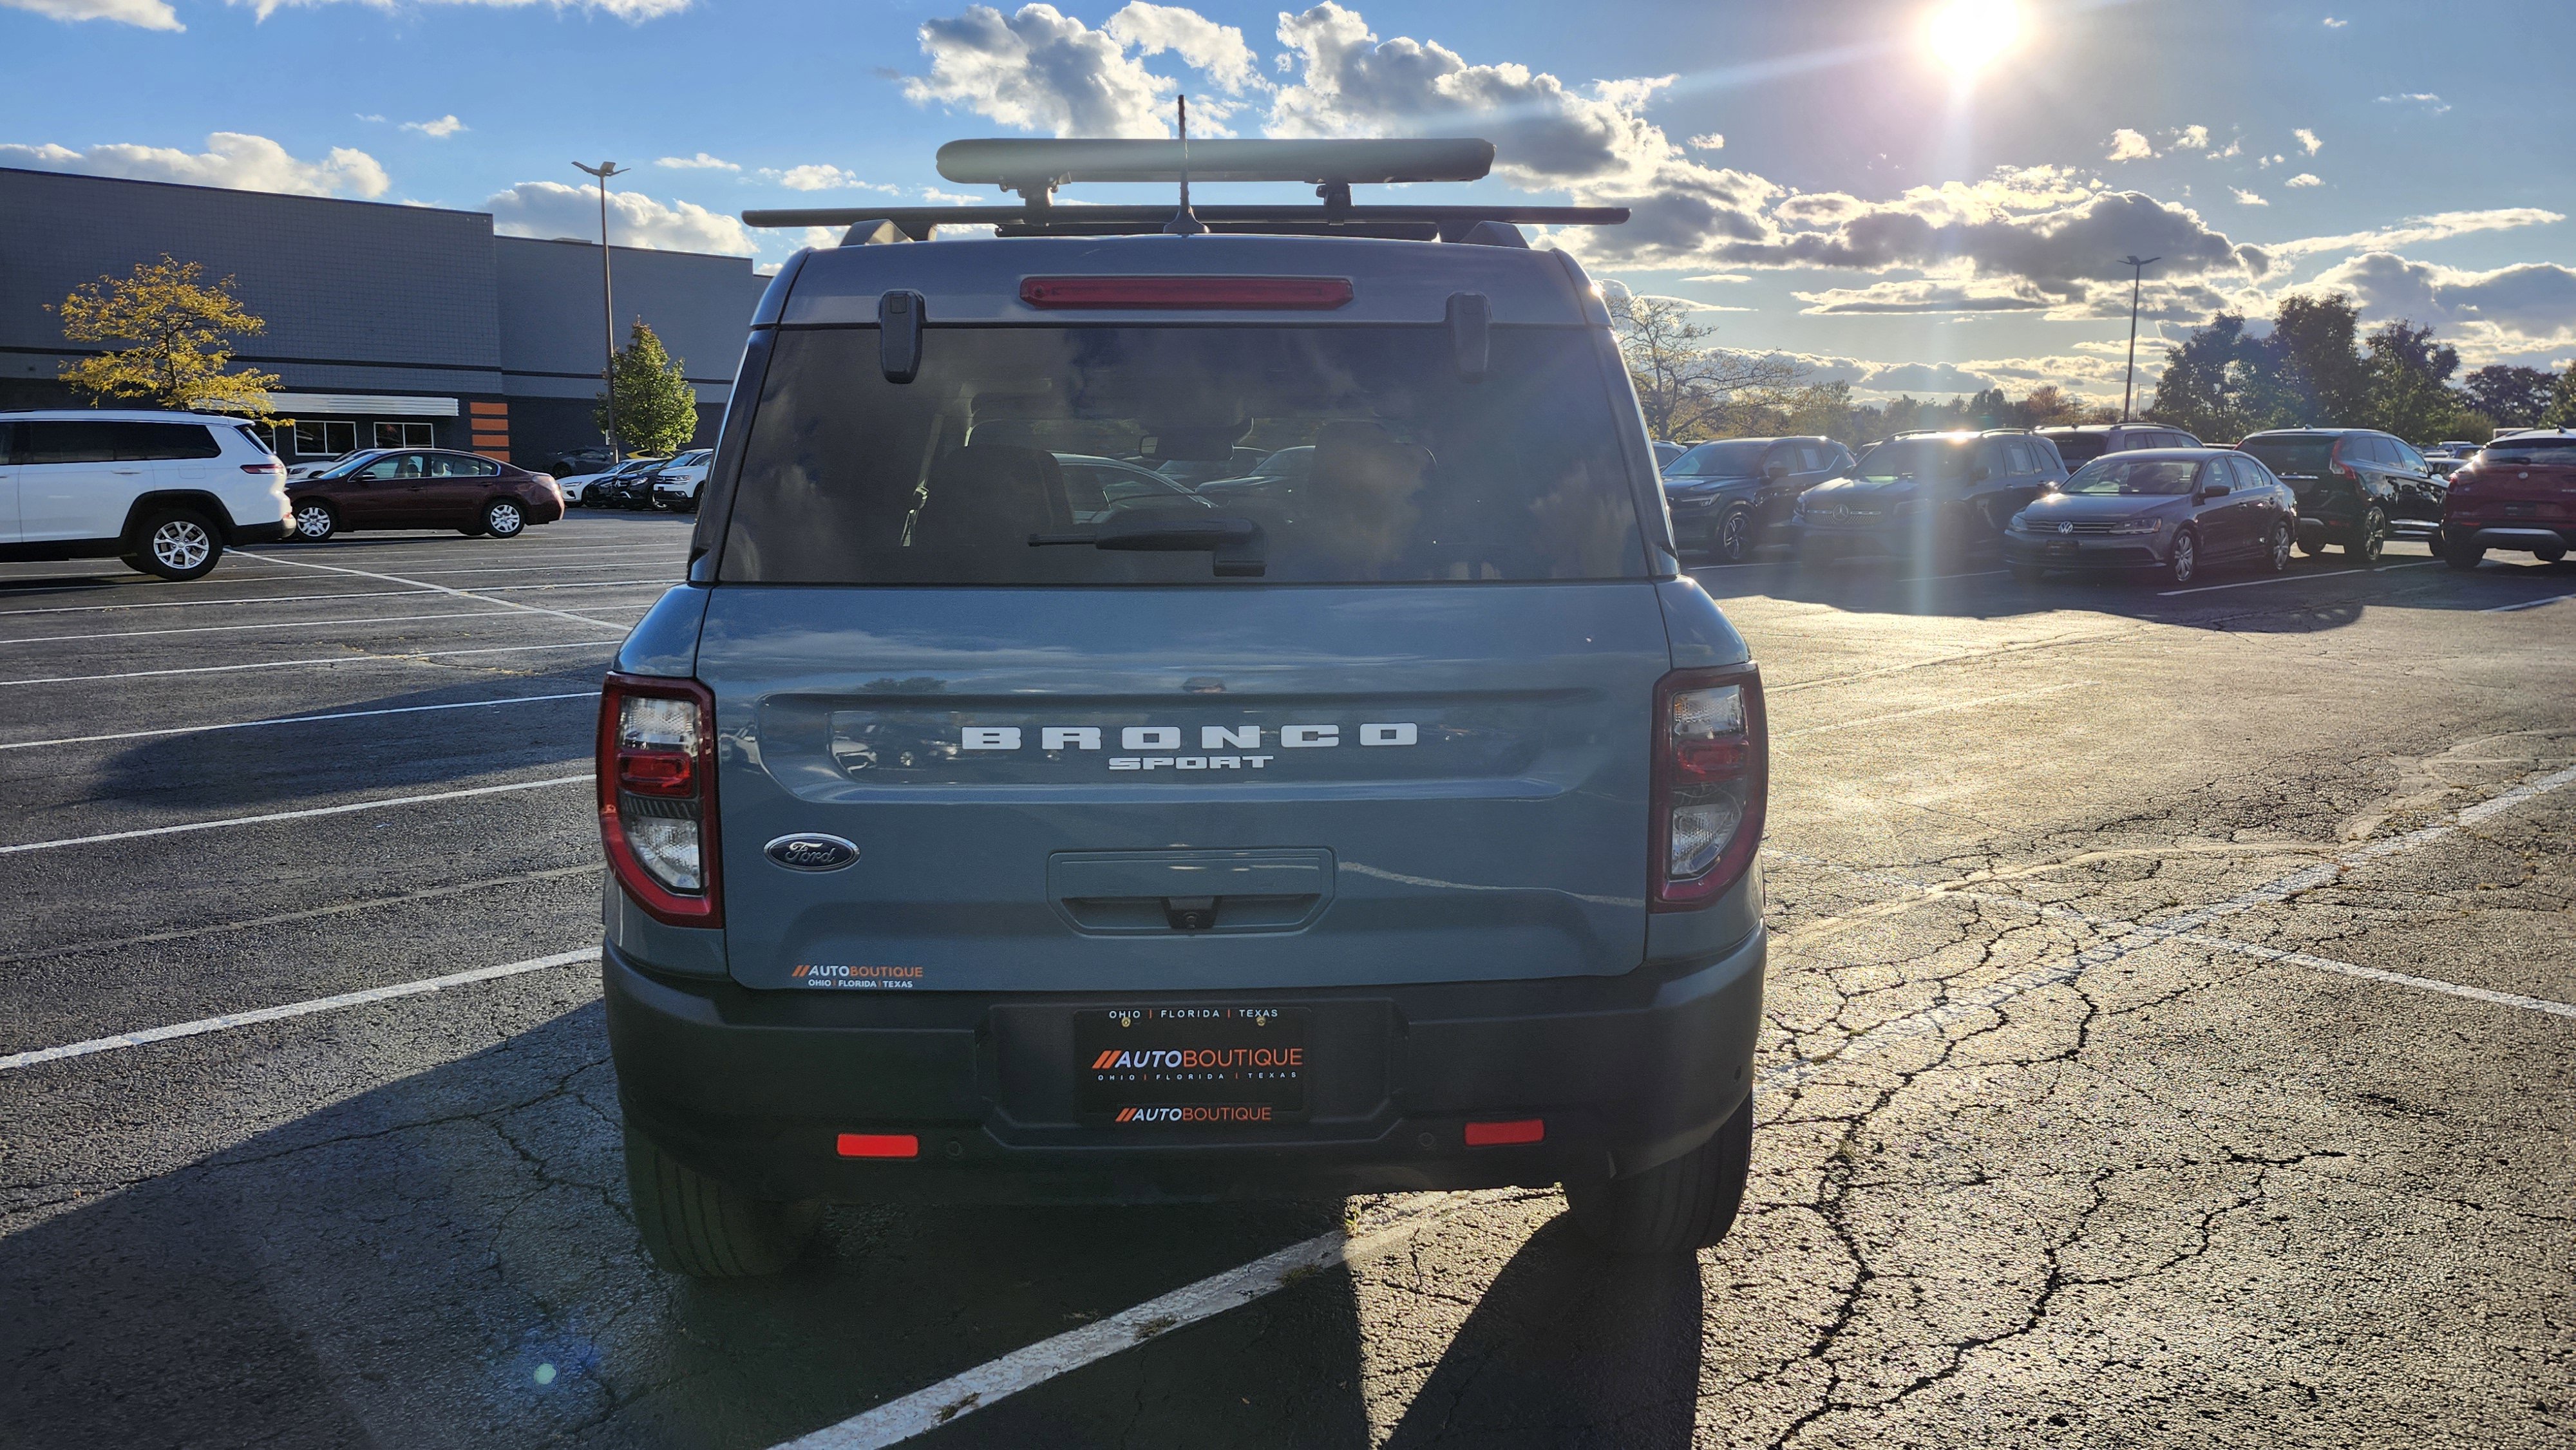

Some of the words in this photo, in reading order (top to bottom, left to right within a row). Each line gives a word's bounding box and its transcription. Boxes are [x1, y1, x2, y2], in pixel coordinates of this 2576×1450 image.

[961, 722, 1417, 750] BRONCO
[1108, 755, 1274, 770] SPORT
[784, 841, 837, 863] Ford
[838, 979, 877, 988] FLORIDA
[883, 980, 913, 988] TEXAS
[1109, 1010, 1141, 1019] OHIO
[1160, 1009, 1220, 1018] FLORIDA
[1239, 1009, 1278, 1018] TEXAS
